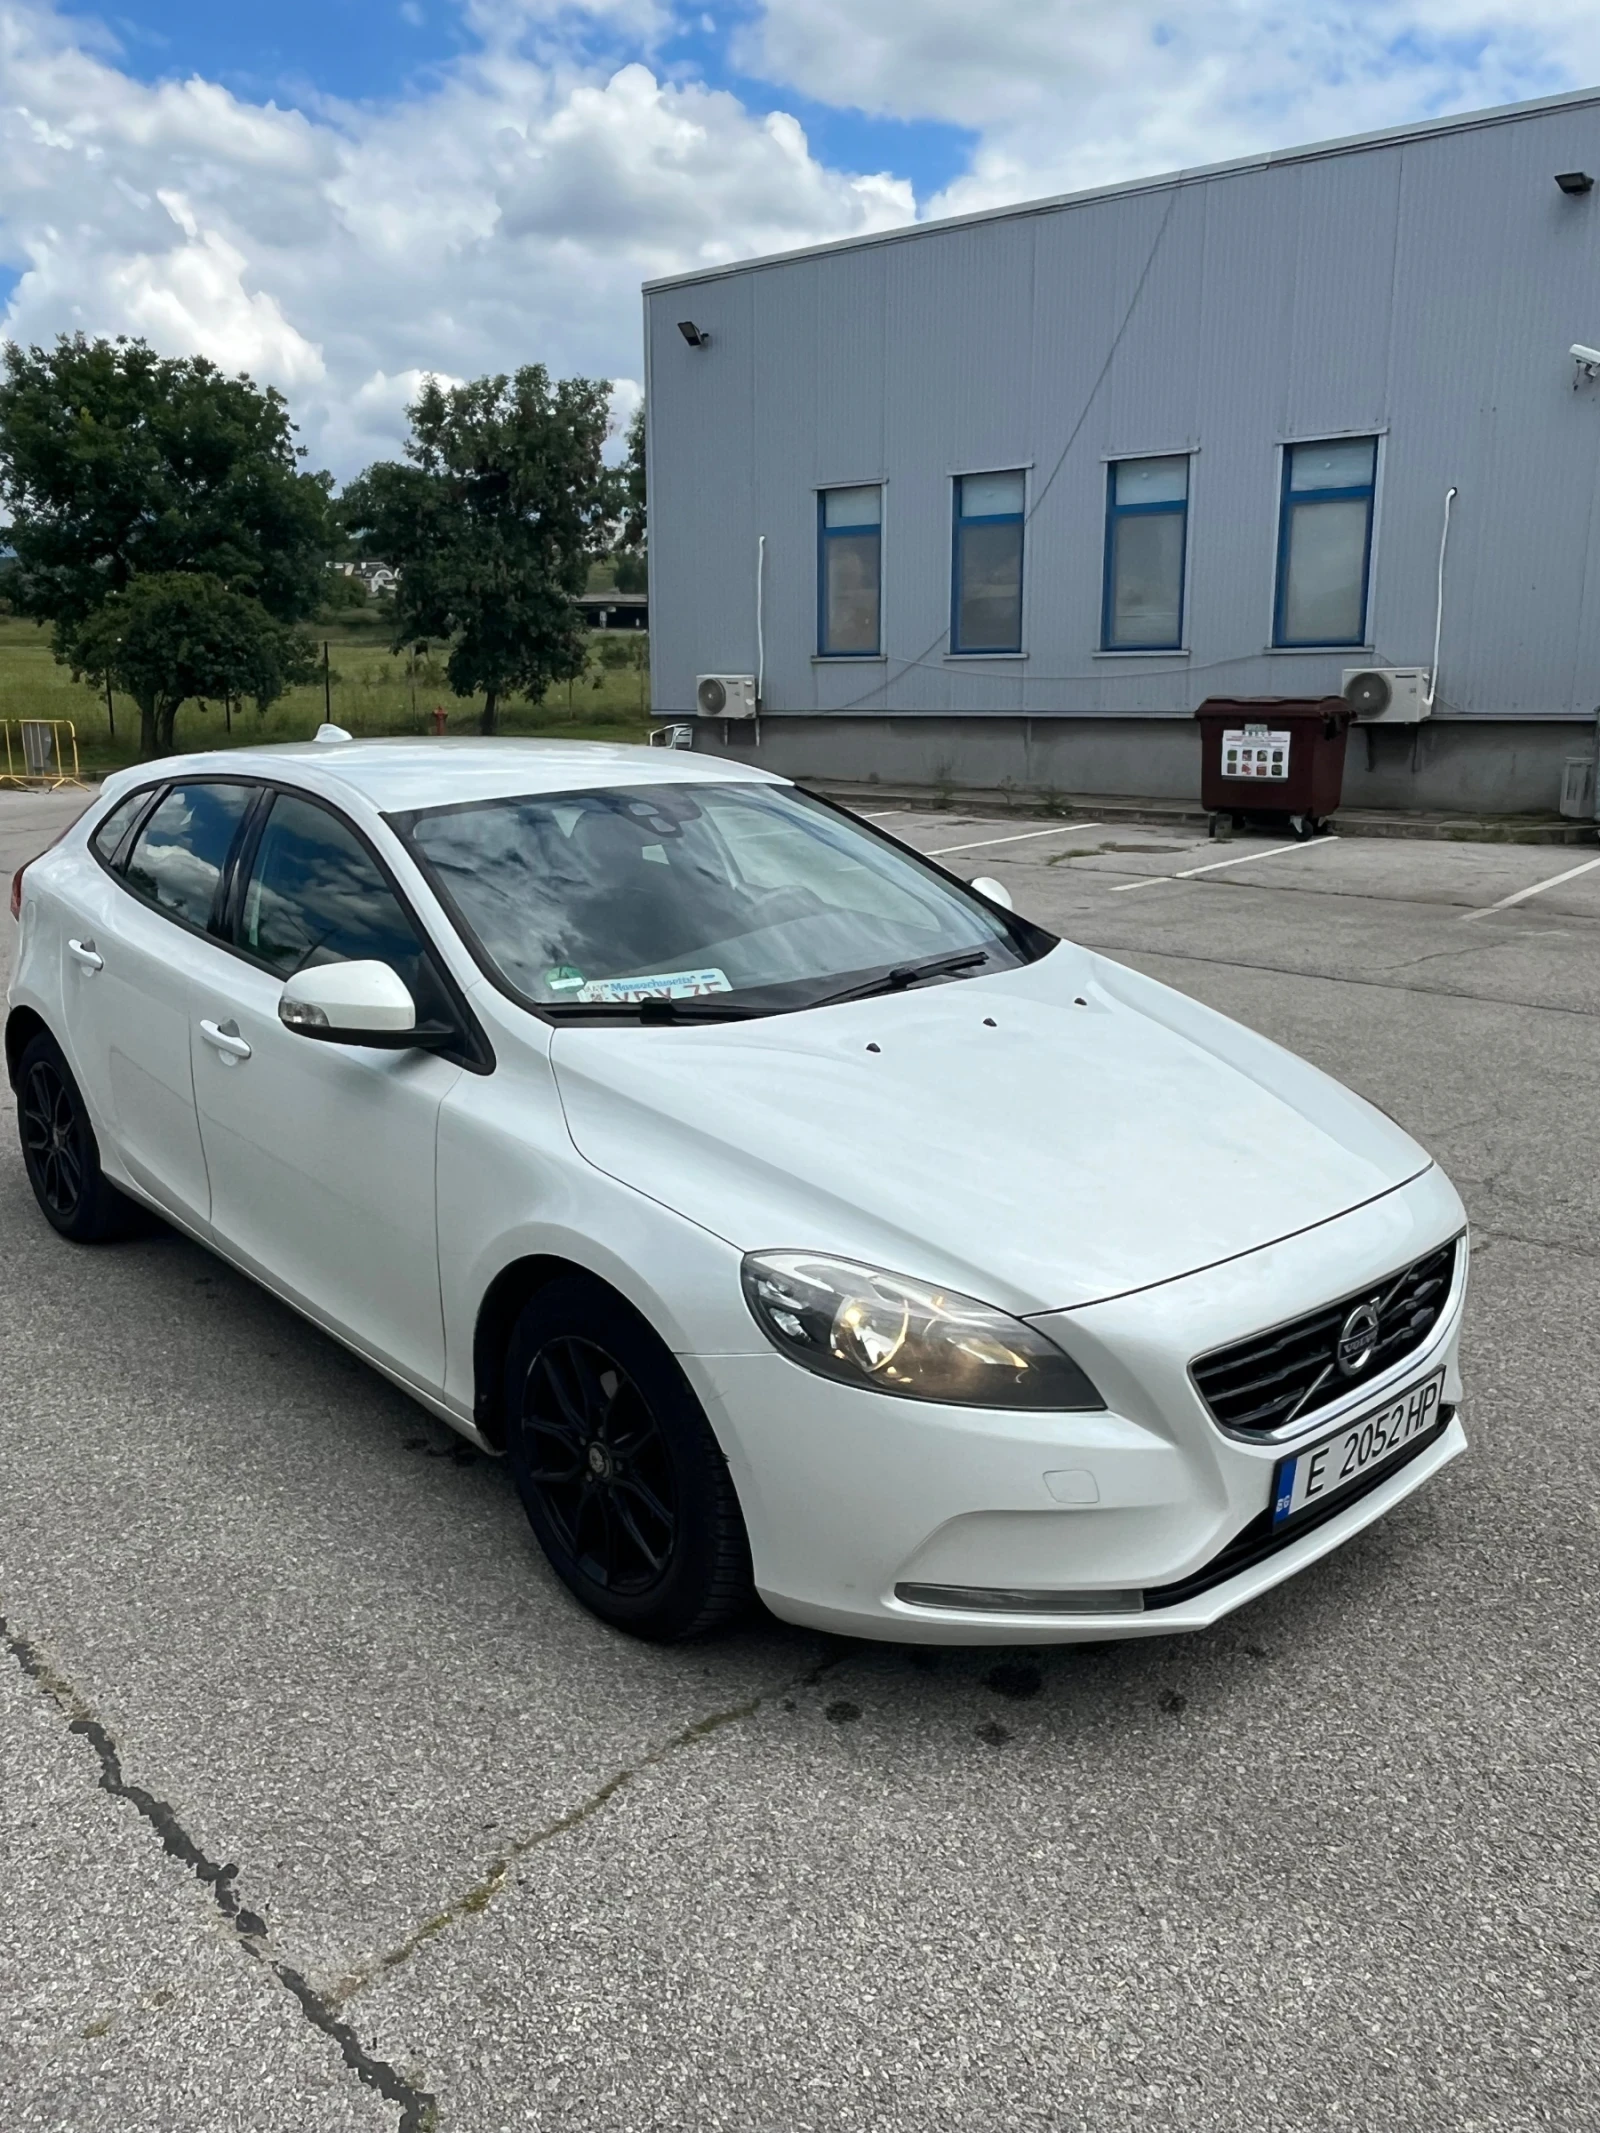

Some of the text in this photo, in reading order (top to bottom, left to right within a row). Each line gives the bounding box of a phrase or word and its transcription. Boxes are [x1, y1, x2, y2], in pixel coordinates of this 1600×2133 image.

[1305, 1382, 1438, 1499] E 2052 HP
